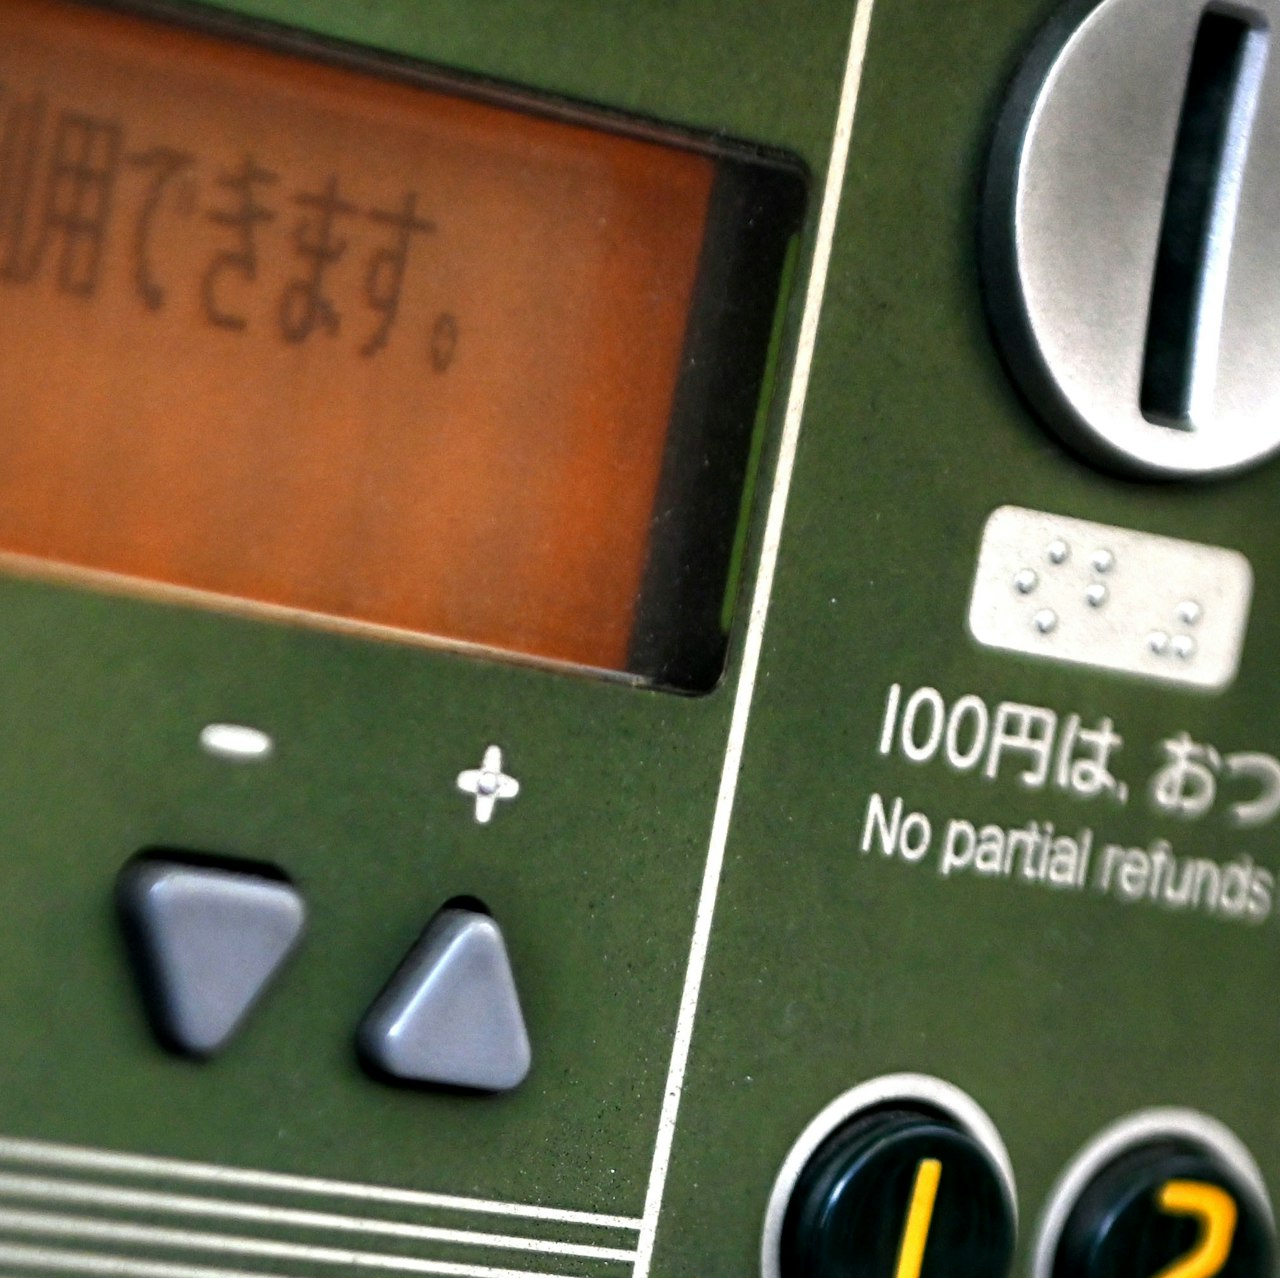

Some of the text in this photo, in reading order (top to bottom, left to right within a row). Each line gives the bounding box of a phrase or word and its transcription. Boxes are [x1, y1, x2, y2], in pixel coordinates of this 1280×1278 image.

[860, 792, 932, 863] No
[938, 817, 1093, 889] partial
[1096, 838, 1275, 924] refunds
